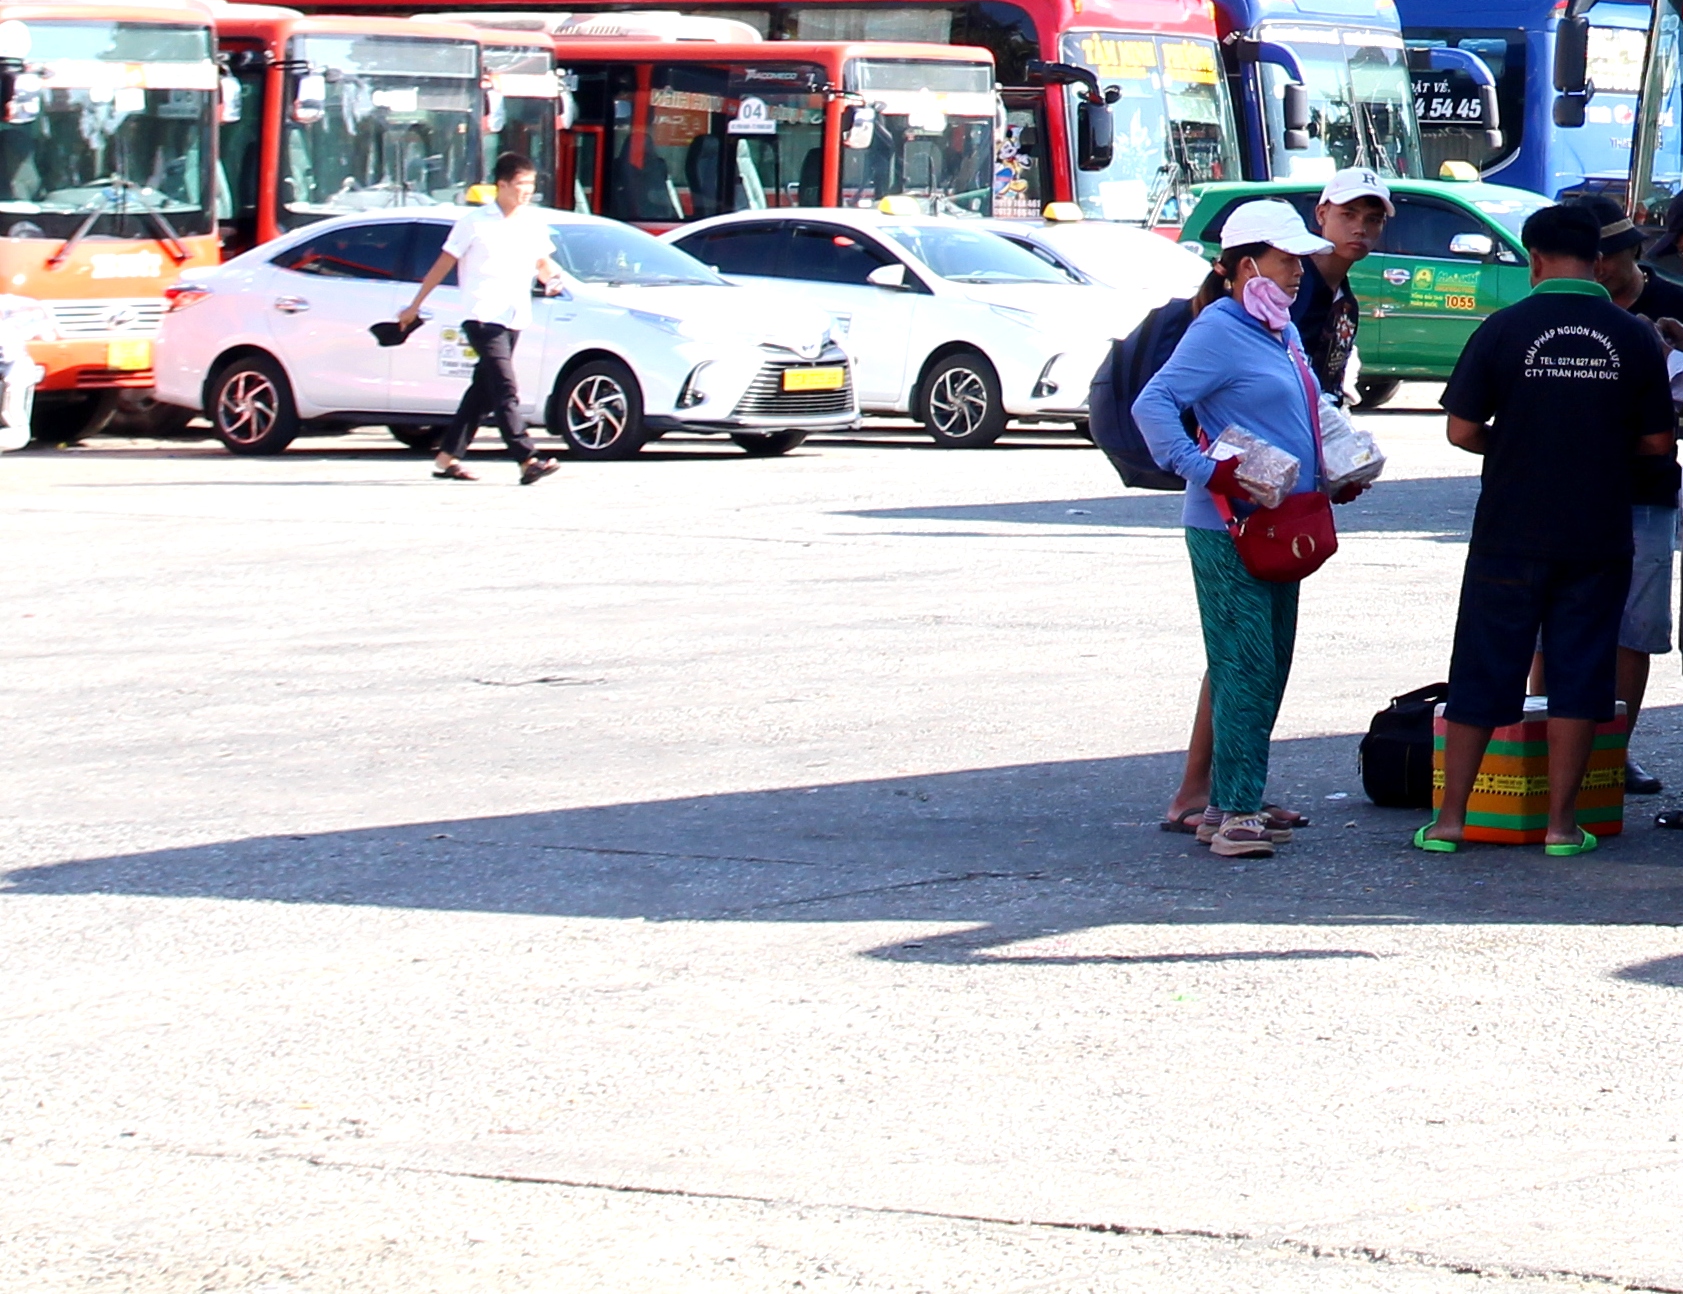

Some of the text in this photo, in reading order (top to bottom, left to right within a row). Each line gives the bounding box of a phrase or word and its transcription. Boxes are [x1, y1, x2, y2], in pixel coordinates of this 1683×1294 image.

[742, 103, 762, 120] 04
[1429, 97, 1454, 118] 54
[1456, 98, 1482, 118] 45
[1362, 172, 1378, 186] R
[1445, 294, 1475, 310] 1055
[1524, 368, 1544, 377] CTY
